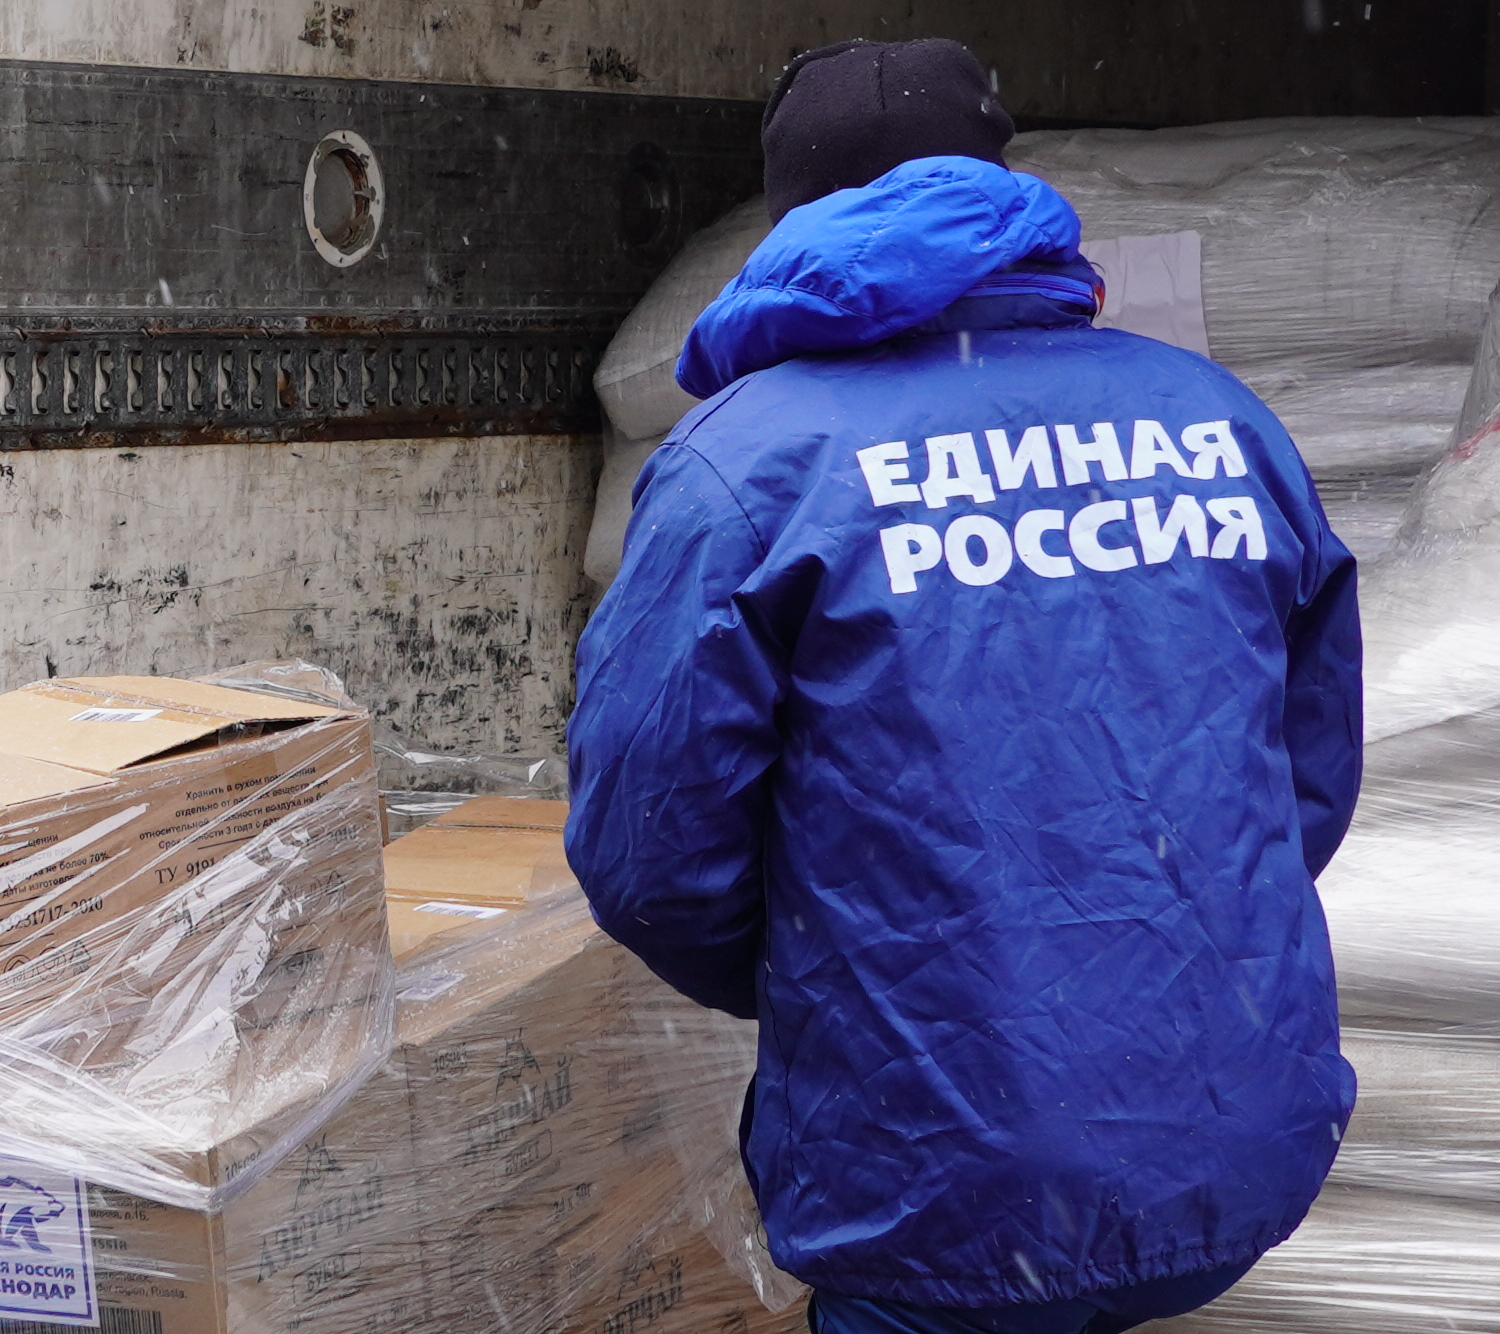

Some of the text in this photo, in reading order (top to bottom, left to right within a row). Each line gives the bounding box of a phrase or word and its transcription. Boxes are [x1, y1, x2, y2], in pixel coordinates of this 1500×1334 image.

[855, 420, 1248, 509] ЕДИНАЯ
[879, 494, 1267, 594] РОССИЯ
[175, 802, 219, 818] отдельно
[155, 866, 177, 886] ТУ
[15, 1263, 75, 1281] РОССИЯ
